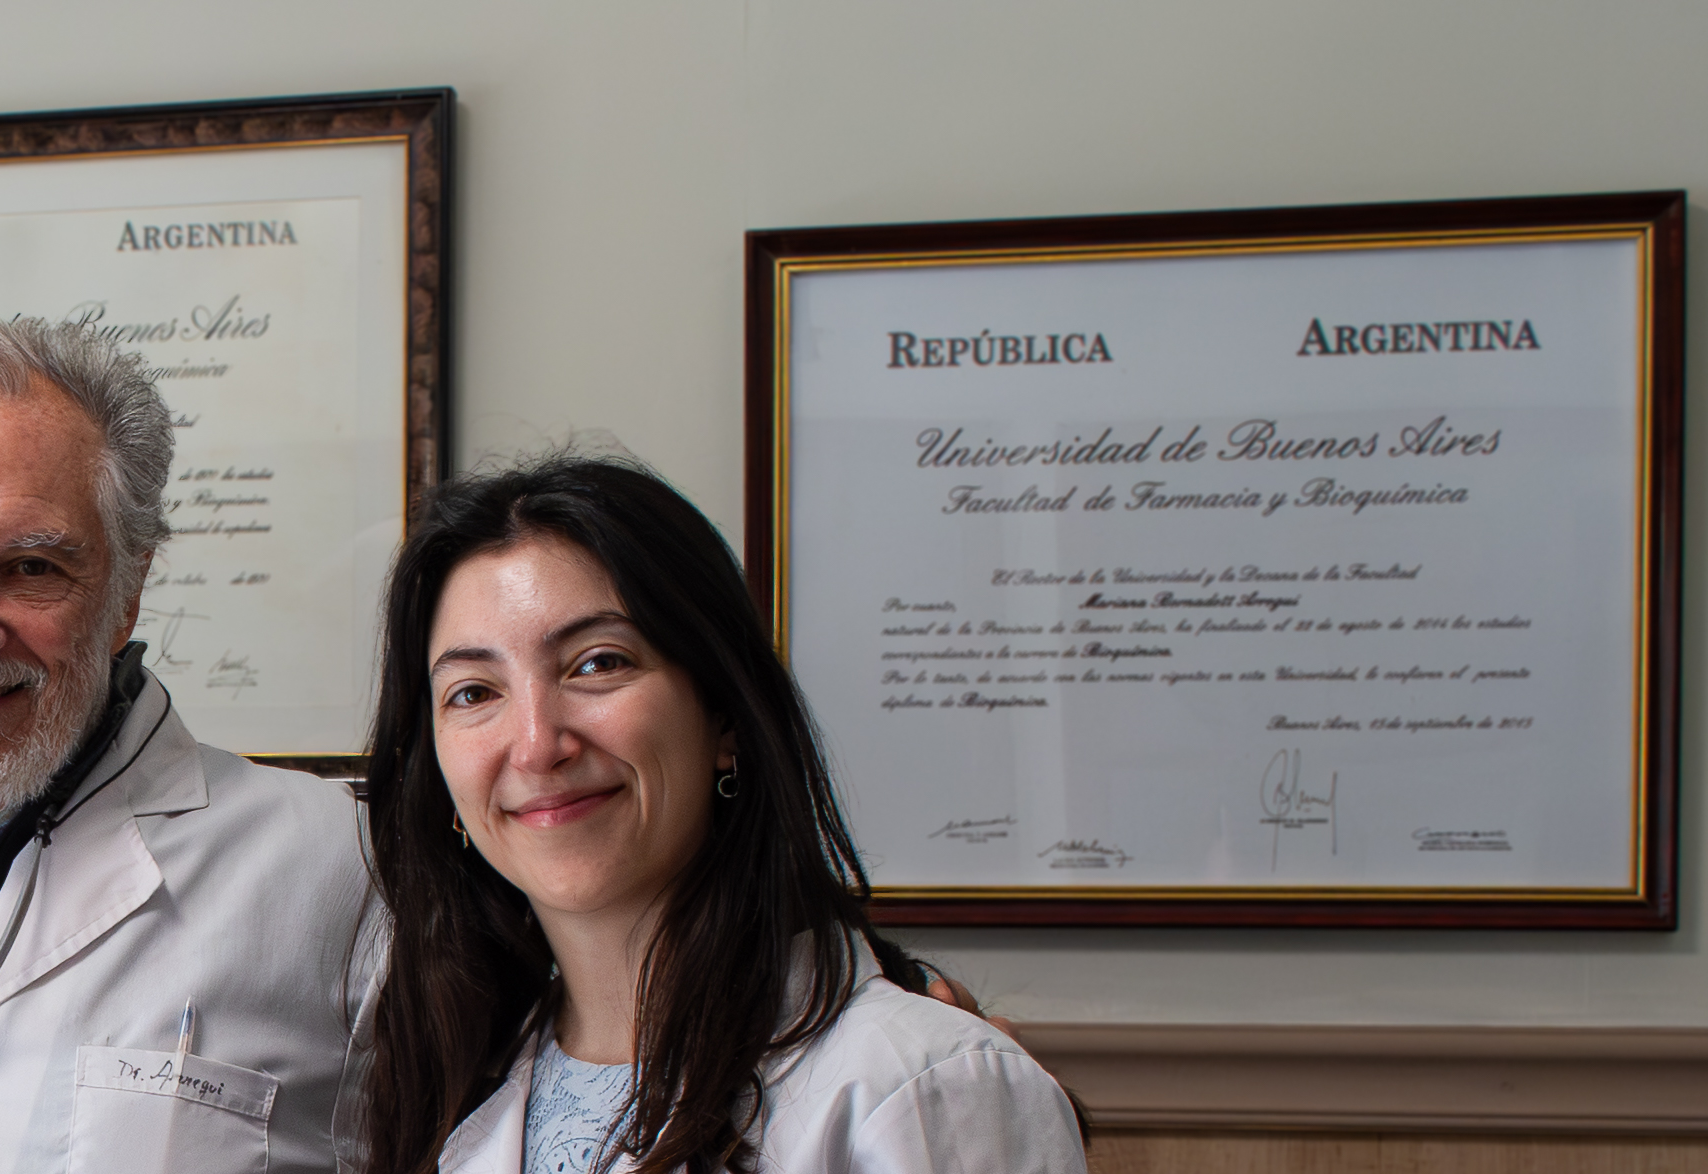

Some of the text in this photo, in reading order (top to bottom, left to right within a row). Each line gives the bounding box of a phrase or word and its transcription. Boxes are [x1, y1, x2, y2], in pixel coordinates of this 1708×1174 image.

[116, 220, 299, 252] ARGENTINA
[179, 294, 273, 343] Aires
[887, 317, 1542, 368] REPÚBLICA ARGENTINA
[142, 356, 231, 384] oquímica
[915, 416, 1503, 468] Universidad de Buenos Aires
[942, 478, 1470, 516] Facultad de Farmacia y Bioquímica
[1012, 568, 1066, 586] Rector
[1068, 568, 1086, 584] de
[1089, 567, 1106, 584] la
[1112, 566, 1201, 585] Universidad
[1202, 570, 1215, 588] y
[1218, 567, 1235, 583] la
[1238, 565, 1298, 582] Decana
[1302, 565, 1321, 582] de
[1323, 564, 1340, 581] la
[1344, 562, 1423, 581] Facultad
[881, 597, 909, 613] Por
[1079, 592, 1147, 610] Mariana
[936, 621, 953, 636] de
[957, 620, 973, 636] la
[976, 619, 1044, 636] Provincia
[1049, 619, 1066, 635] de
[1071, 618, 1123, 635] Buenos
[1316, 617, 1332, 632] de
[1339, 619, 1383, 635] agosto
[1388, 617, 1404, 631] de
[1477, 614, 1532, 630] estudios
[1061, 644, 1077, 659] de
[881, 669, 910, 686] Por
[975, 670, 992, 684] de
[997, 669, 1048, 684] acuerdo
[1105, 672, 1154, 684] normas
[1471, 668, 1531, 684] presente
[939, 694, 955, 709] de
[1265, 714, 1321, 732] Buenos
[1403, 714, 1474, 734] septiembre
[1476, 714, 1494, 730] de
[113, 1059, 145, 1081] Dr.
